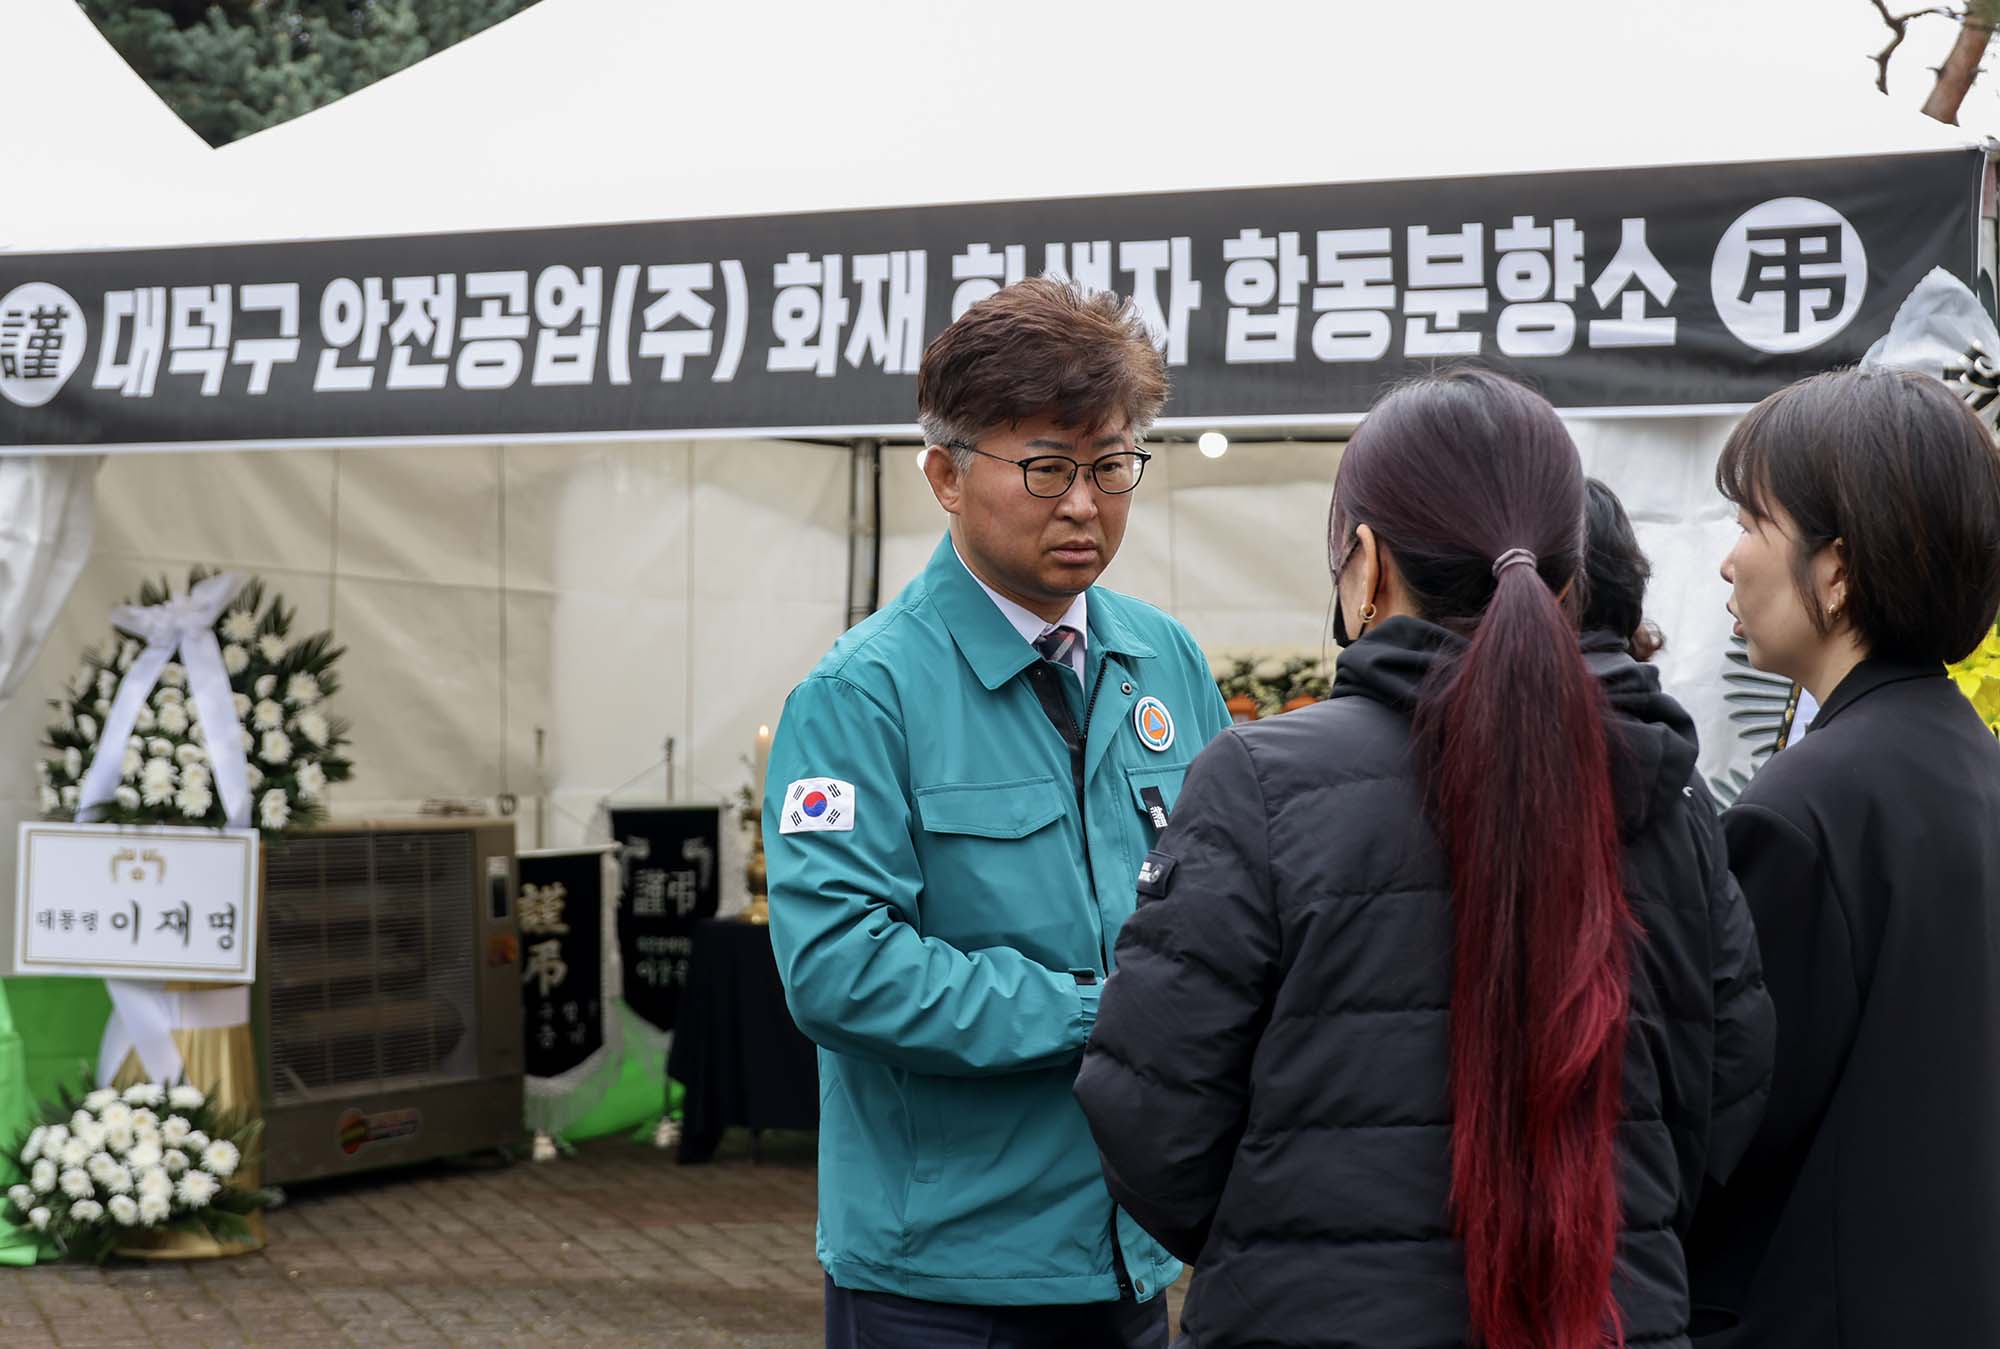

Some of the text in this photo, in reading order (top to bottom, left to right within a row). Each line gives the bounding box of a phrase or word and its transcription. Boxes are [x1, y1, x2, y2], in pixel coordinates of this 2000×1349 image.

[92, 282, 300, 397] 대덕구
[313, 259, 749, 392] 안전공업(주)
[766, 250, 927, 378] 화재
[1223, 215, 1678, 364] 합동분향소
[1736, 222, 1847, 333] 弔
[36, 899, 237, 951] 대통령 이재명
